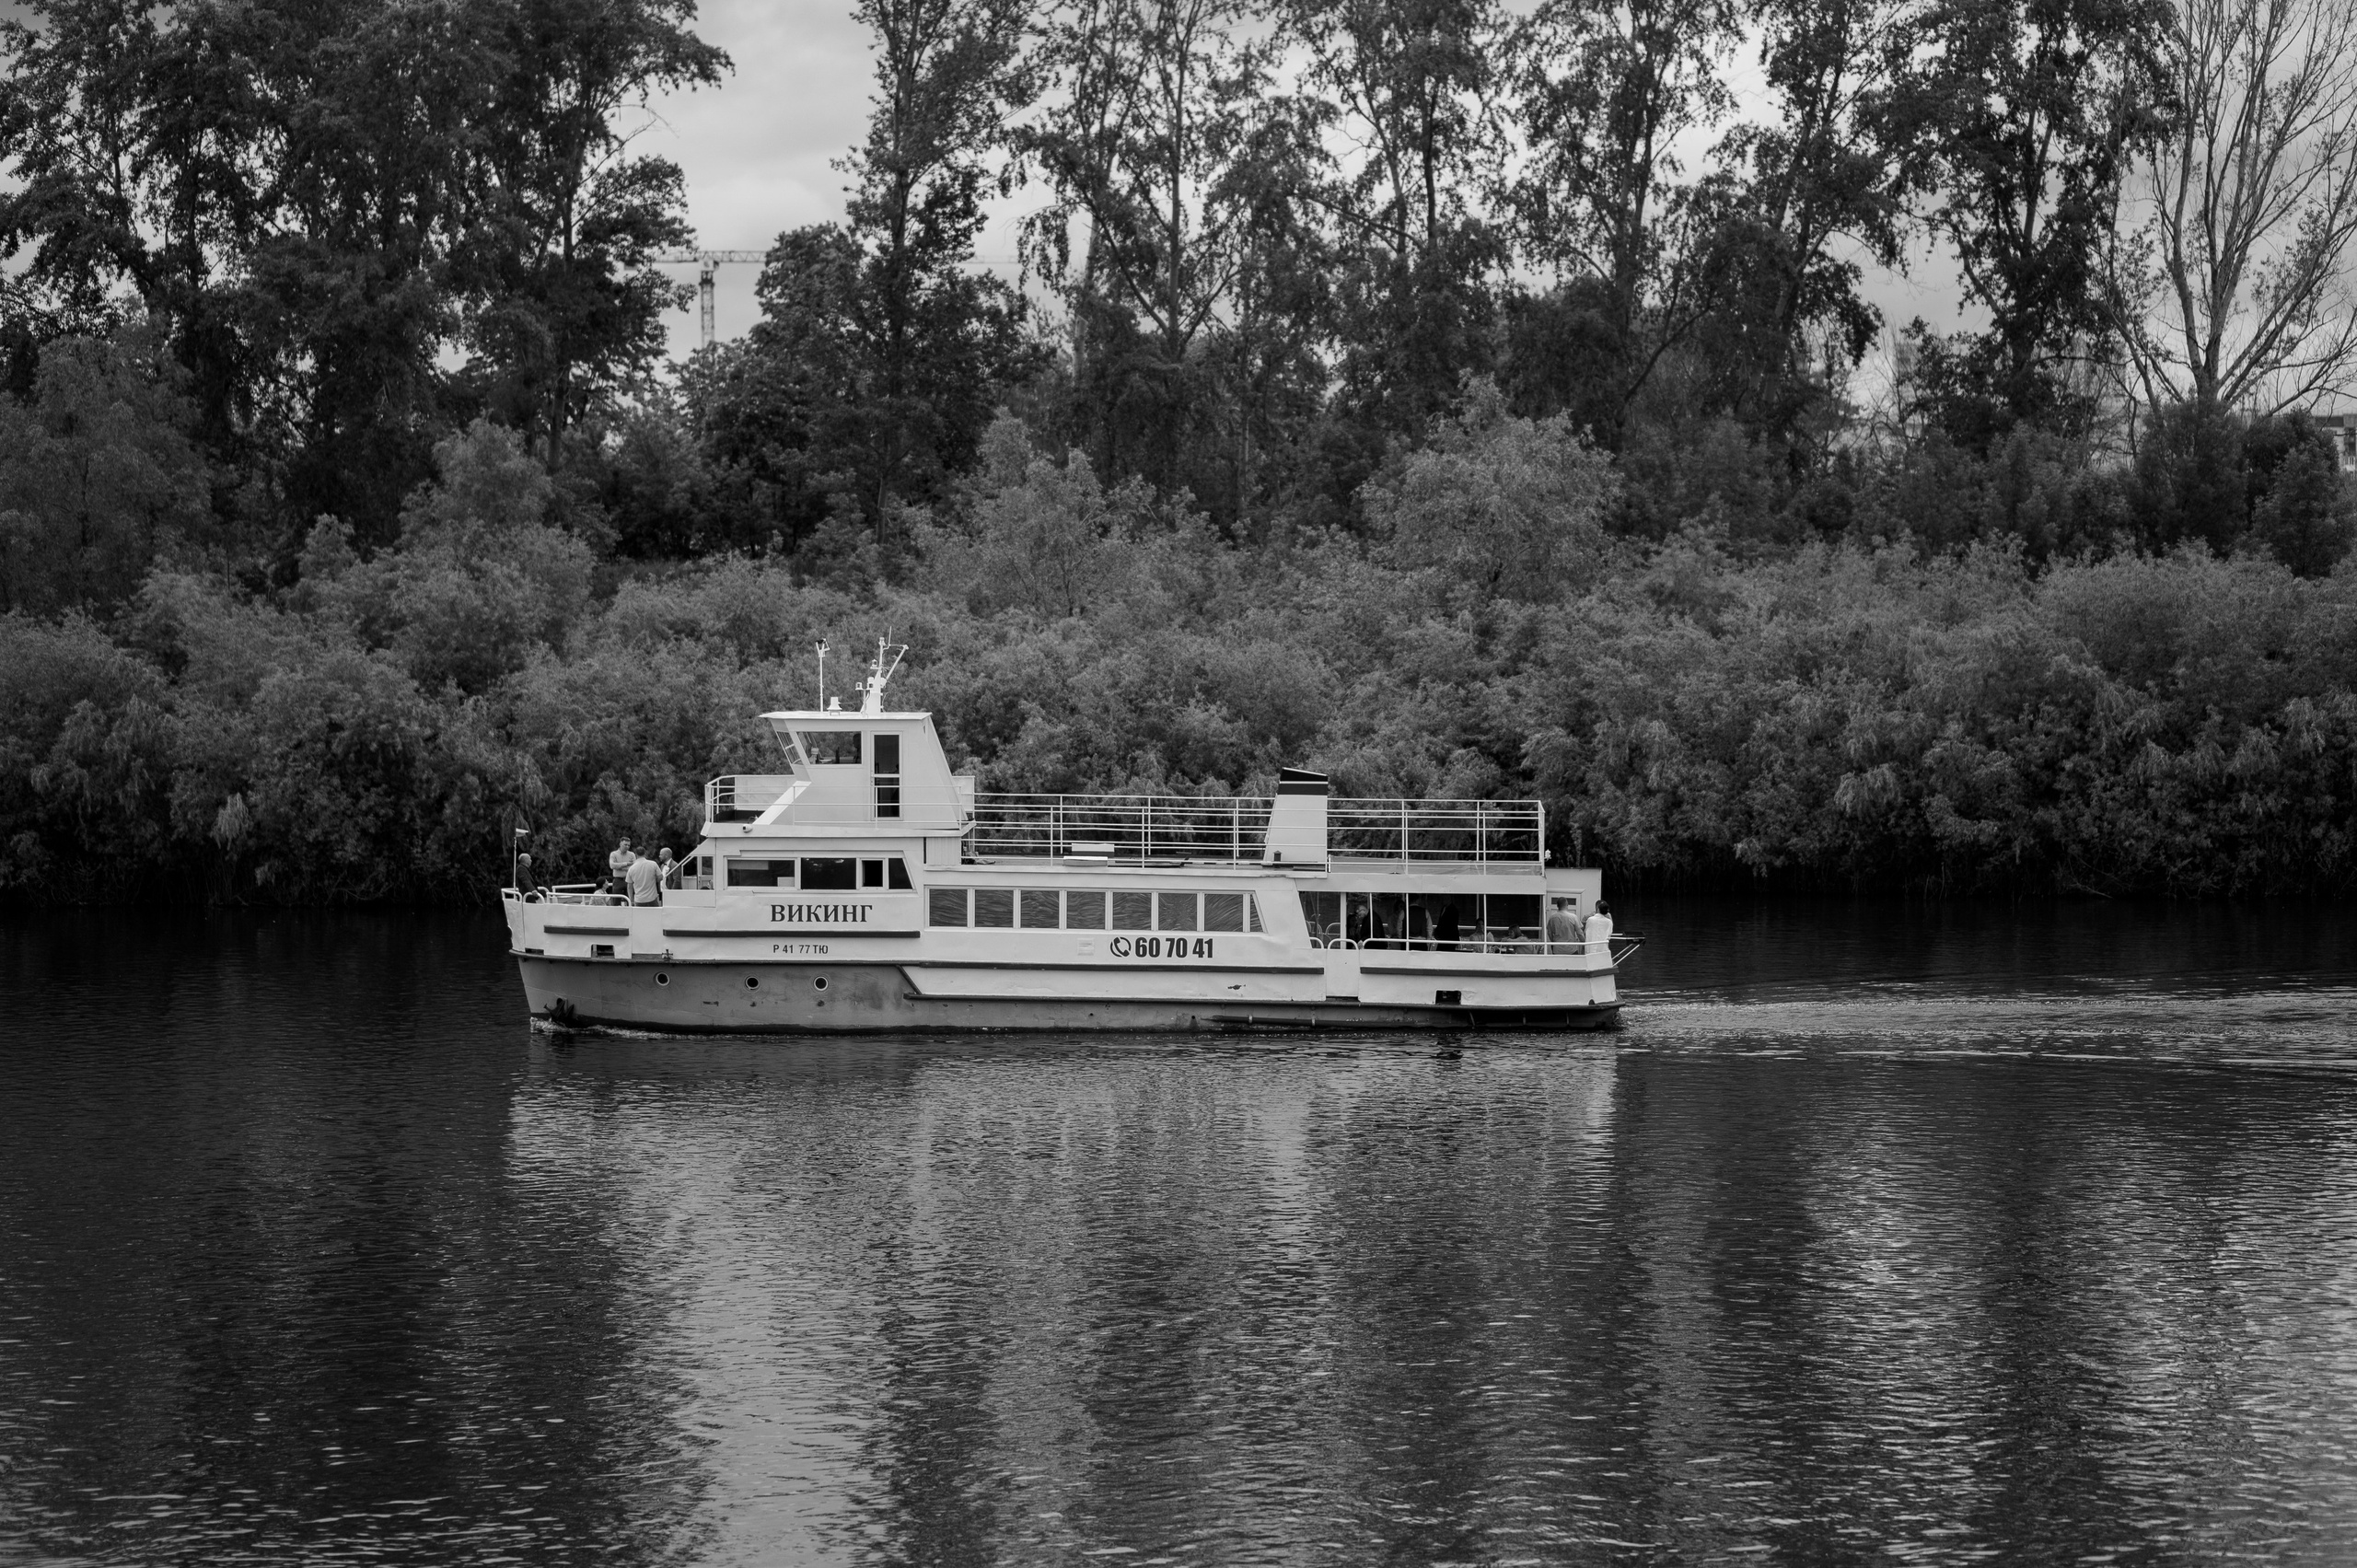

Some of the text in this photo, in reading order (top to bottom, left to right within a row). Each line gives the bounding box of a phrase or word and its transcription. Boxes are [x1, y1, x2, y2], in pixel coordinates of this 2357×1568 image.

[770, 904, 873, 923] ВИКИНГ
[783, 944, 794, 954] 41
[1134, 936, 1213, 958] 60 70 41
